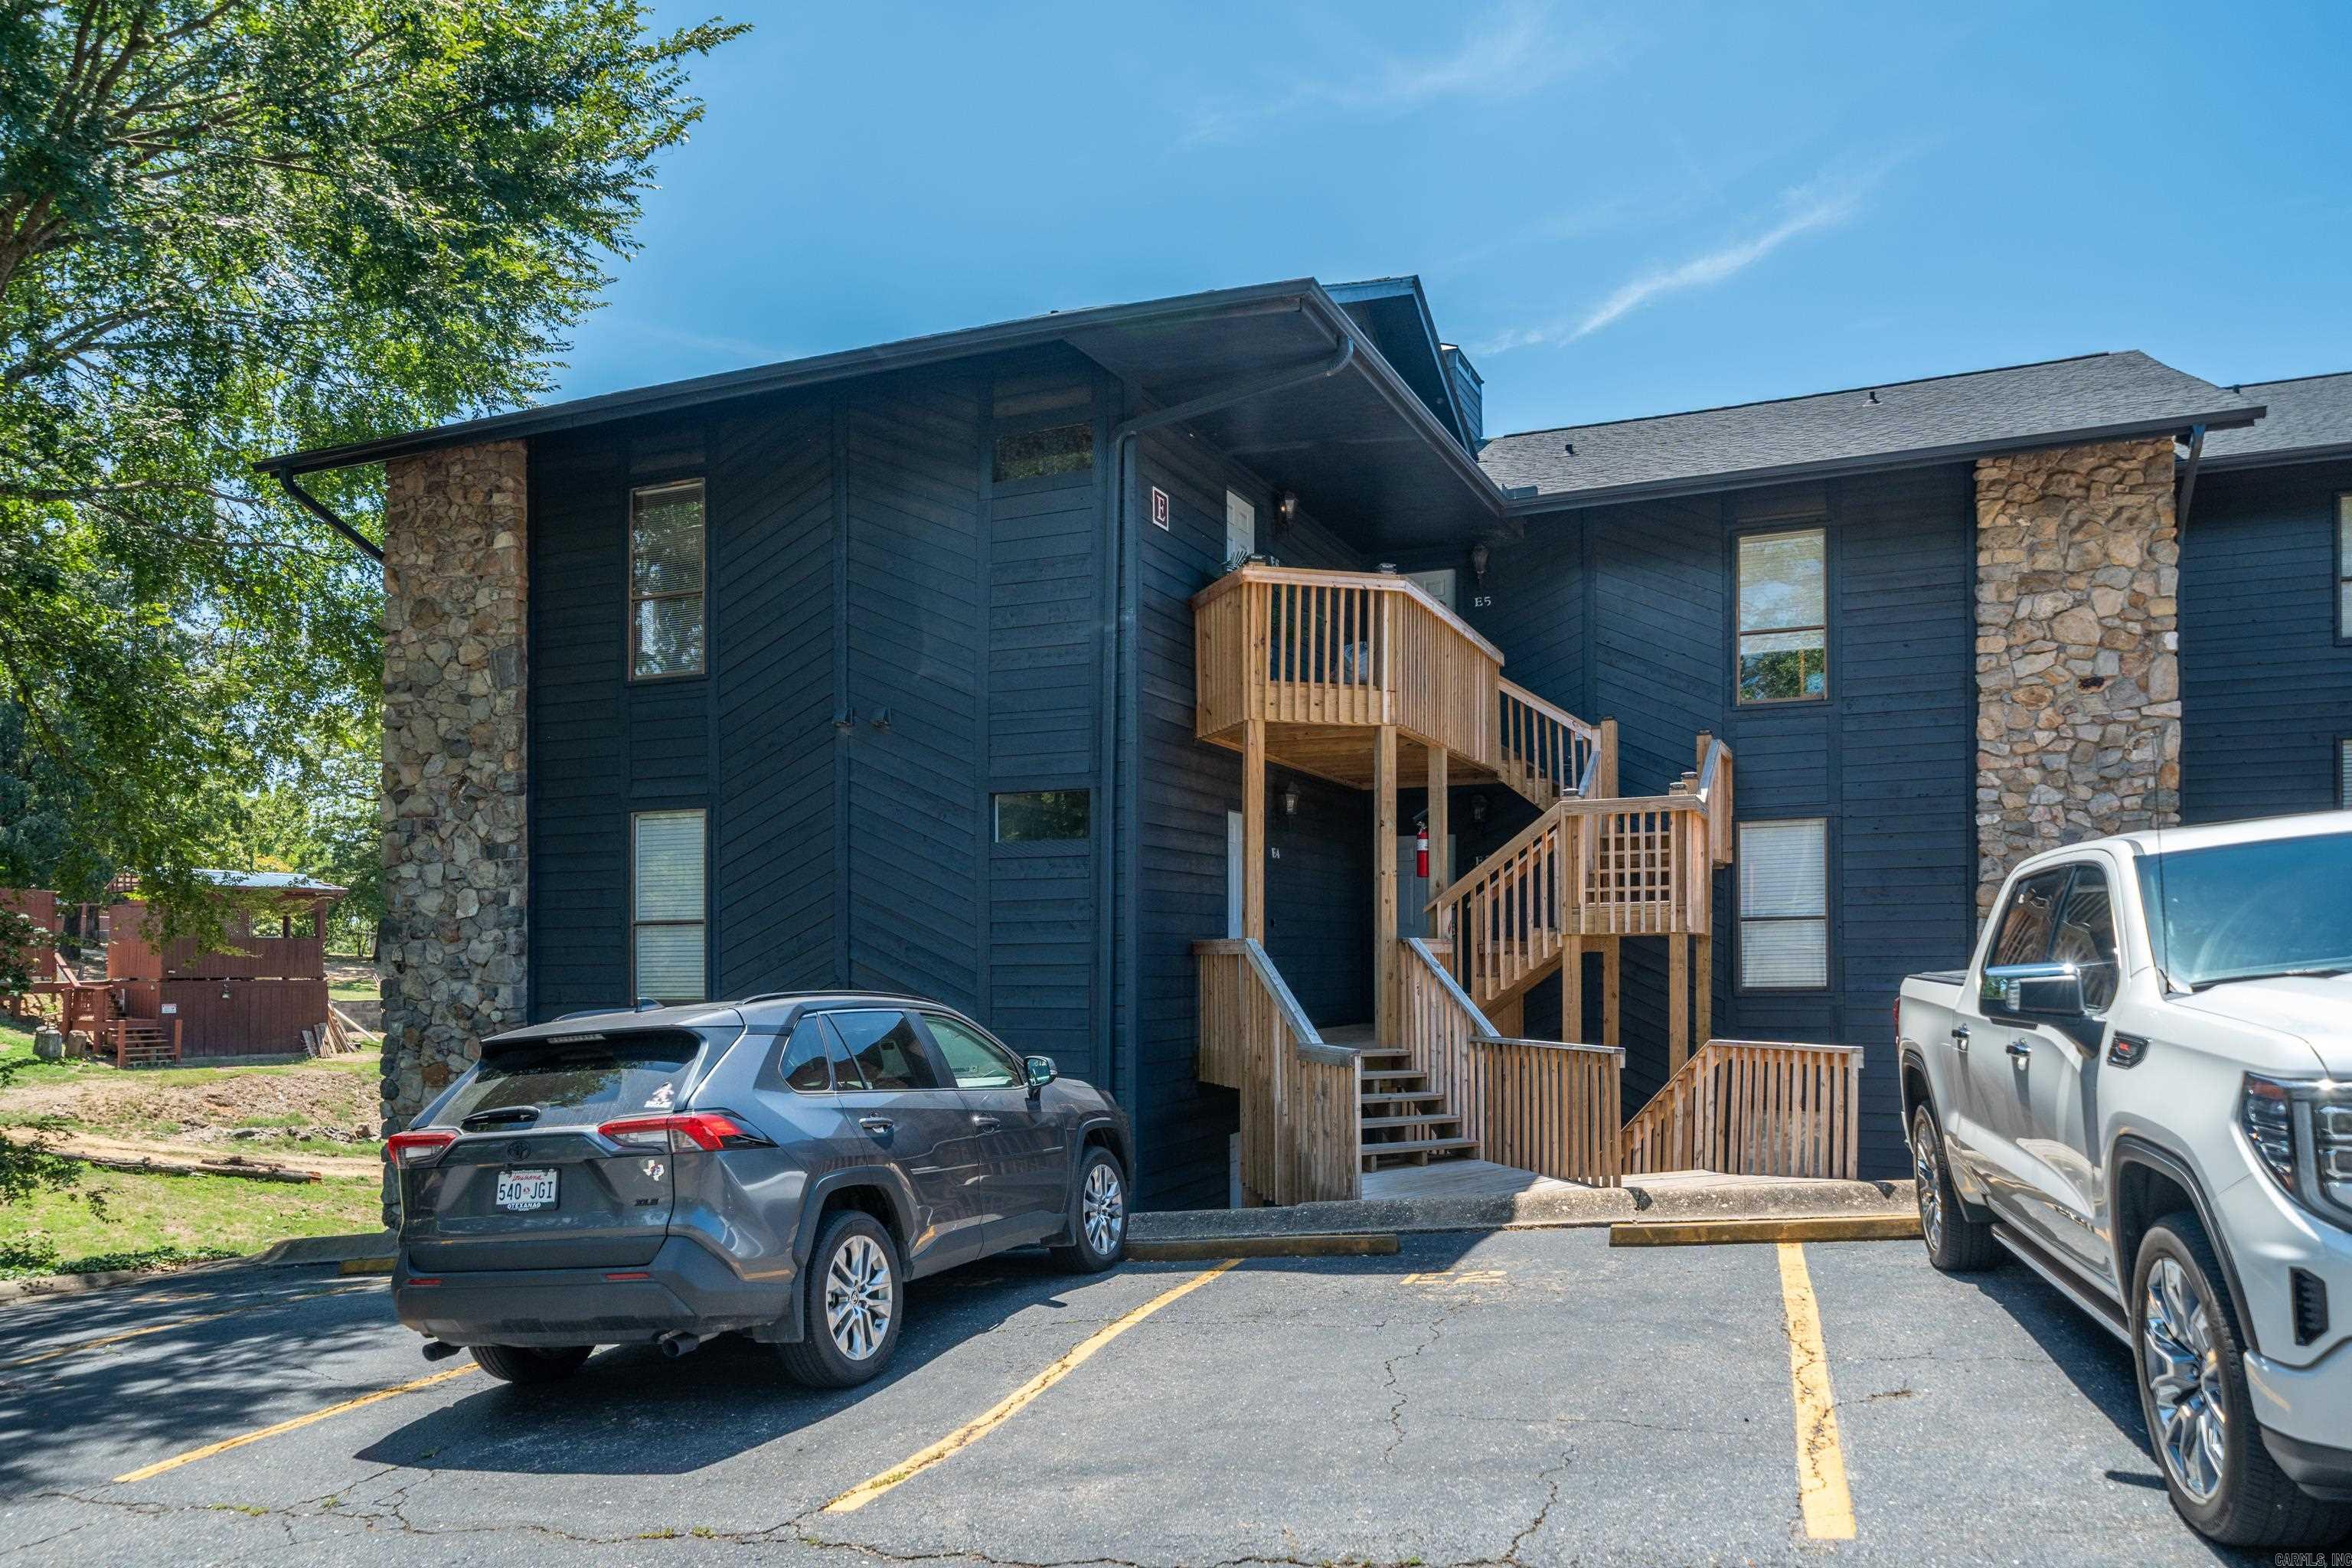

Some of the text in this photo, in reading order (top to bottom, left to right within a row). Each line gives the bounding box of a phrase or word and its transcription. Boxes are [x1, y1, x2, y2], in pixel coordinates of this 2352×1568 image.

[1156, 495, 1165, 522] E
[1475, 596, 1491, 606] E5
[1271, 848, 1280, 858] E4
[498, 1181, 553, 1200] 540 JGI
